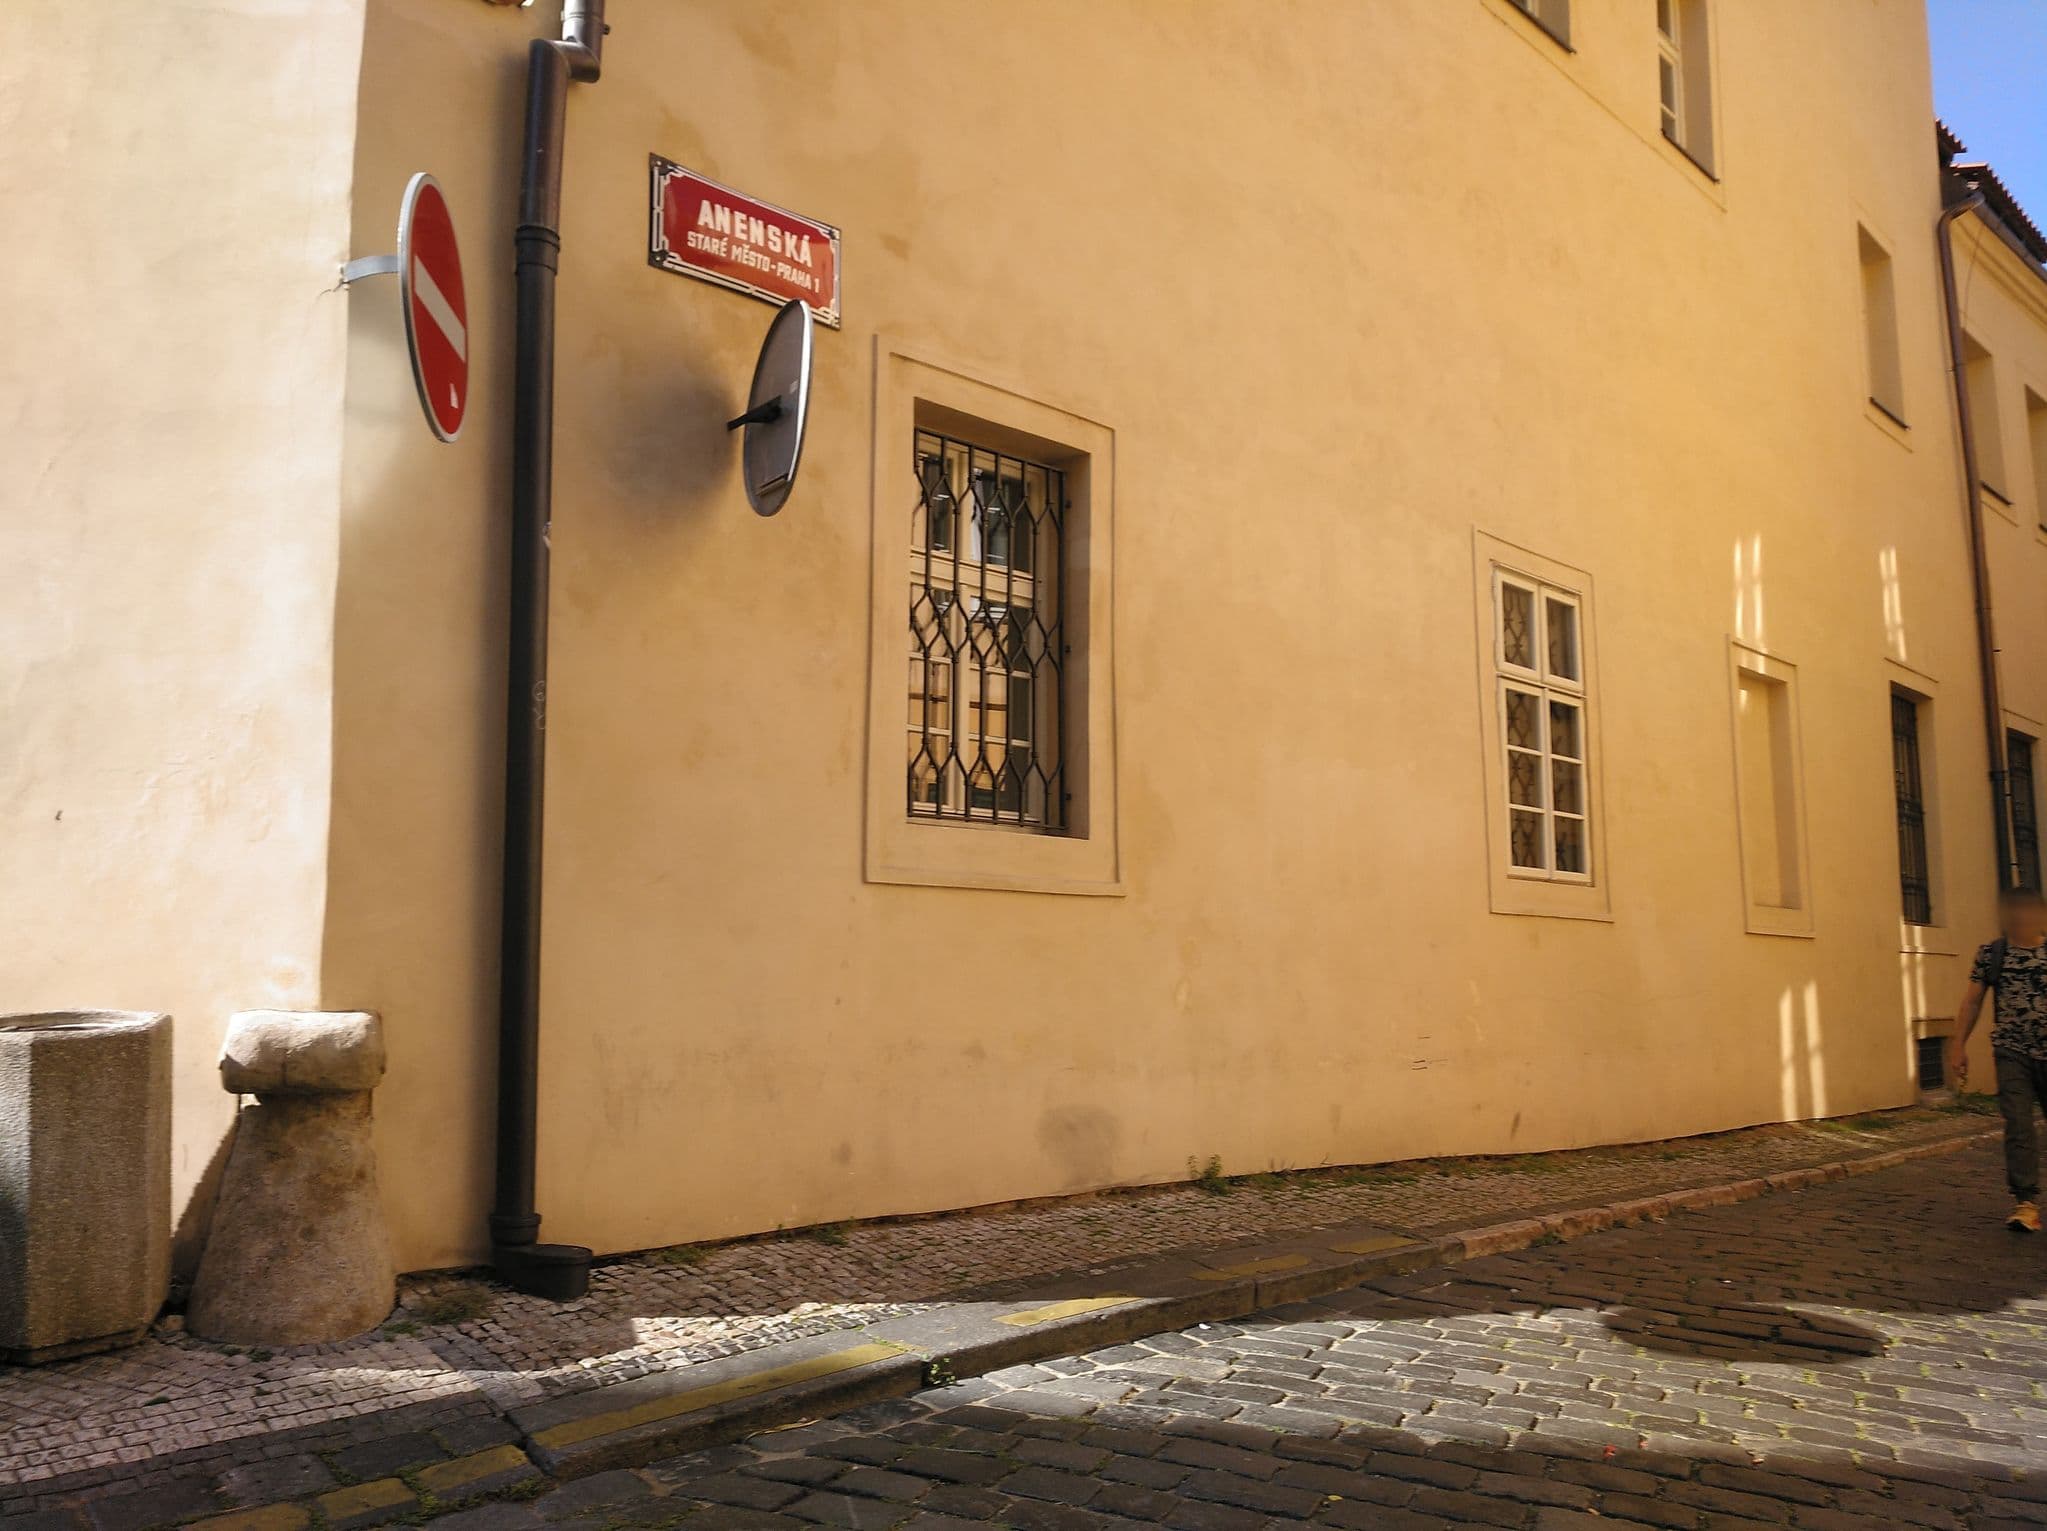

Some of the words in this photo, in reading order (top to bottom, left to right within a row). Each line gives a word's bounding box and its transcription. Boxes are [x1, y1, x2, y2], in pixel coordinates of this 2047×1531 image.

[687, 231, 728, 257] STARÉ
[814, 279, 820, 293] 1
[698, 200, 813, 268] ANENSKÁ
